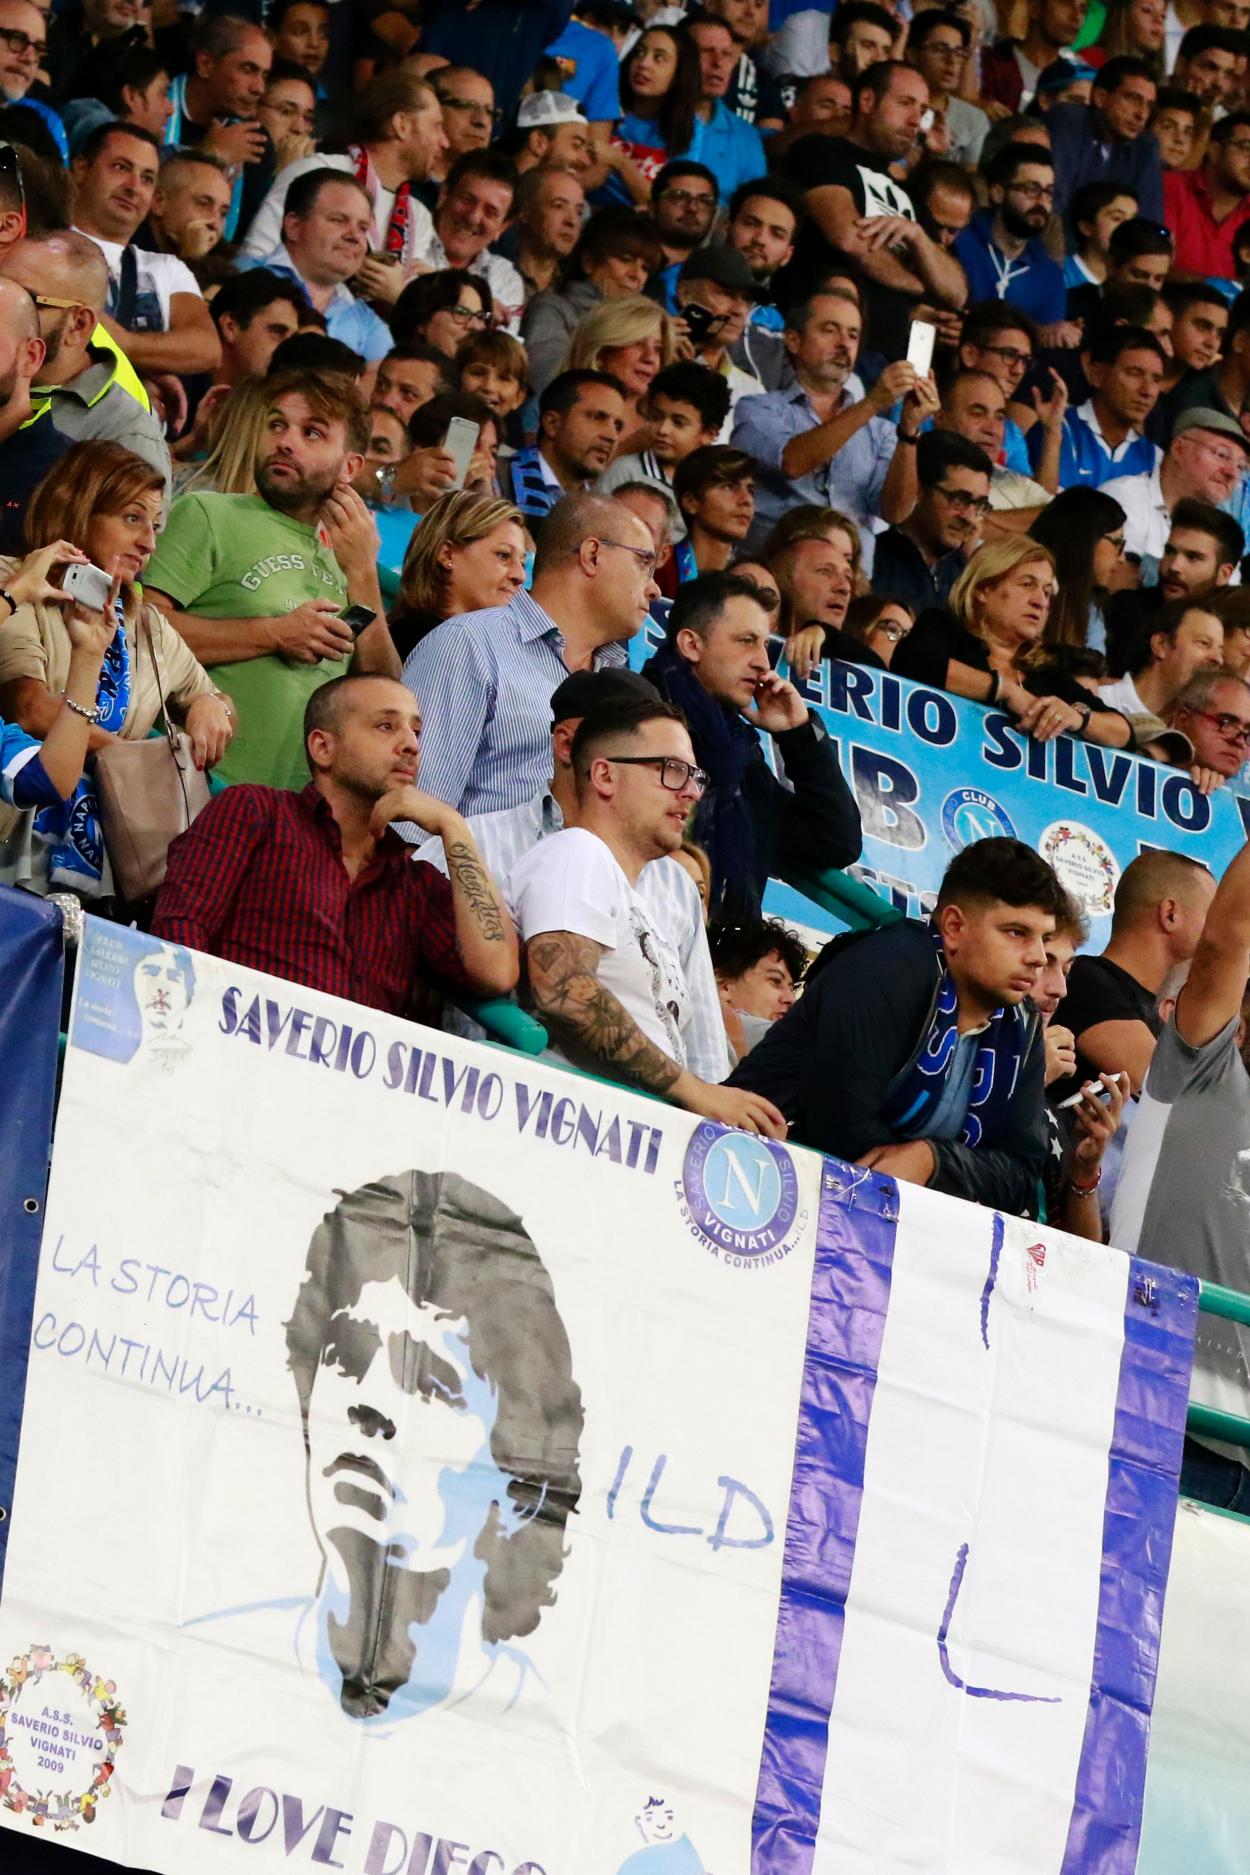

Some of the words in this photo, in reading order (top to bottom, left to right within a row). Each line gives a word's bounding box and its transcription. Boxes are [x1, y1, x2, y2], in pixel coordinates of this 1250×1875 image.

[240, 554, 305, 592] GUESS
[961, 790, 996, 811] CLUB
[982, 712, 1212, 833] SILVIO
[218, 985, 377, 1079] SAVERIO
[382, 1040, 504, 1121] SILVIO
[514, 1081, 663, 1175] VIGNATI
[689, 1125, 717, 1209] SAVERIO
[777, 1158, 794, 1223] SILVIO
[673, 1179, 685, 1202] LA
[680, 1206, 720, 1258] STORIA
[703, 1211, 777, 1250] VIGNATI
[52, 1234, 102, 1288] LA
[110, 1258, 260, 1337] STORIA
[33, 1312, 263, 1417] CONTINUA...
[606, 1444, 775, 1553] ILD
[10, 1711, 60, 1738] SAVERIO
[61, 1729, 104, 1751] SILVIO
[30, 1735, 77, 1761] VIGNATI
[40, 1705, 74, 1726] A.S.S.
[37, 1755, 64, 1774] 2009
[160, 1763, 195, 1821] I
[198, 1773, 354, 1869] LOVE
